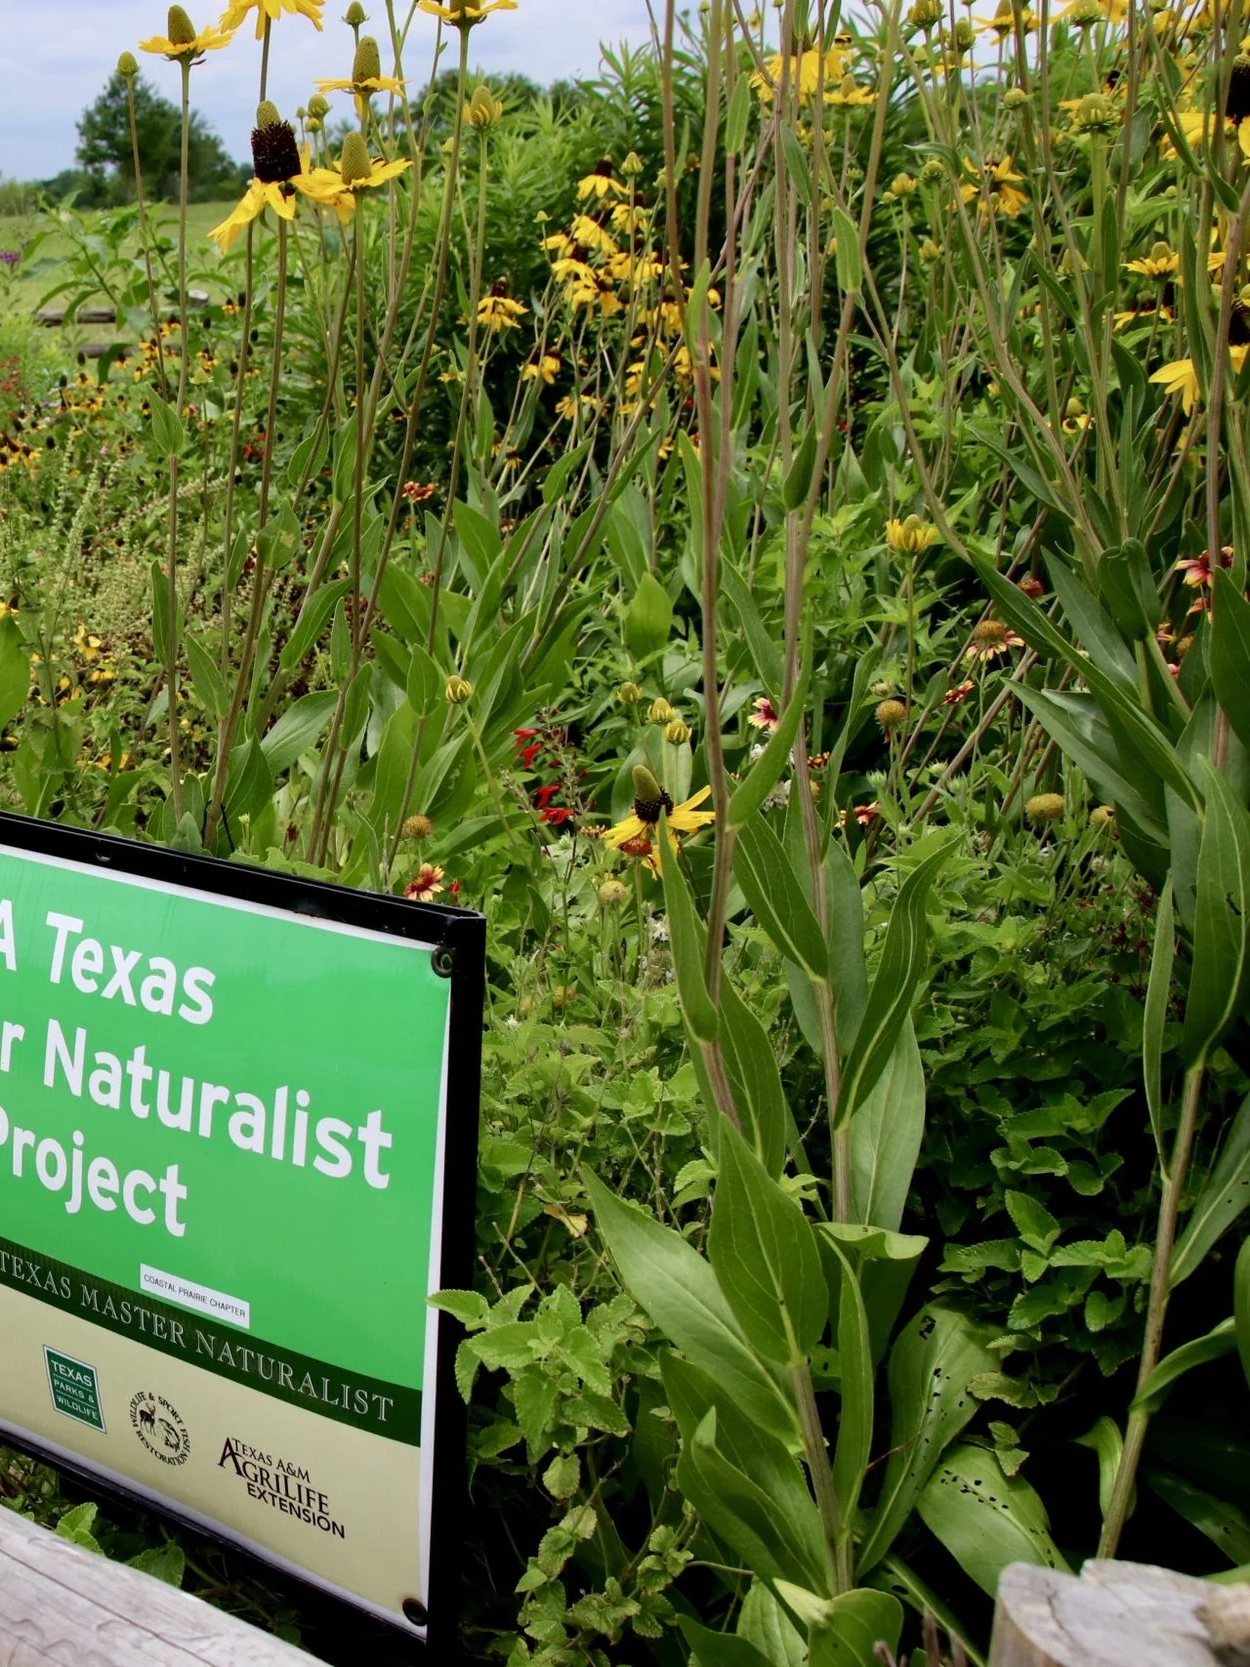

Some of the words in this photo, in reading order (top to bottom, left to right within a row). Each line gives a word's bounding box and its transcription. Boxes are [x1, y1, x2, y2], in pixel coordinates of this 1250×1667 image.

[45, 911, 216, 1025] Texas
[43, 1018, 393, 1190] Naturalist
[143, 1273, 178, 1293] COASTAL
[178, 1286, 208, 1305] PRAIRIE
[209, 1297, 247, 1319] CHAPTER
[50, 1359, 93, 1387] TEXAS
[80, 1283, 187, 1349] MASTER
[194, 1328, 394, 1422] NATURALIST
[53, 1379, 85, 1399] PARKS
[88, 1394, 95, 1404] &
[56, 1394, 99, 1420] WILDLIFE
[129, 1391, 148, 1428] WILDLIFE
[157, 1395, 184, 1426] SPORT
[179, 1428, 191, 1453] FISH
[135, 1430, 189, 1466] RESTORATION
[231, 1438, 273, 1467] TEXAS
[275, 1457, 312, 1485] A&M
[246, 1482, 346, 1540] EXTENSION
